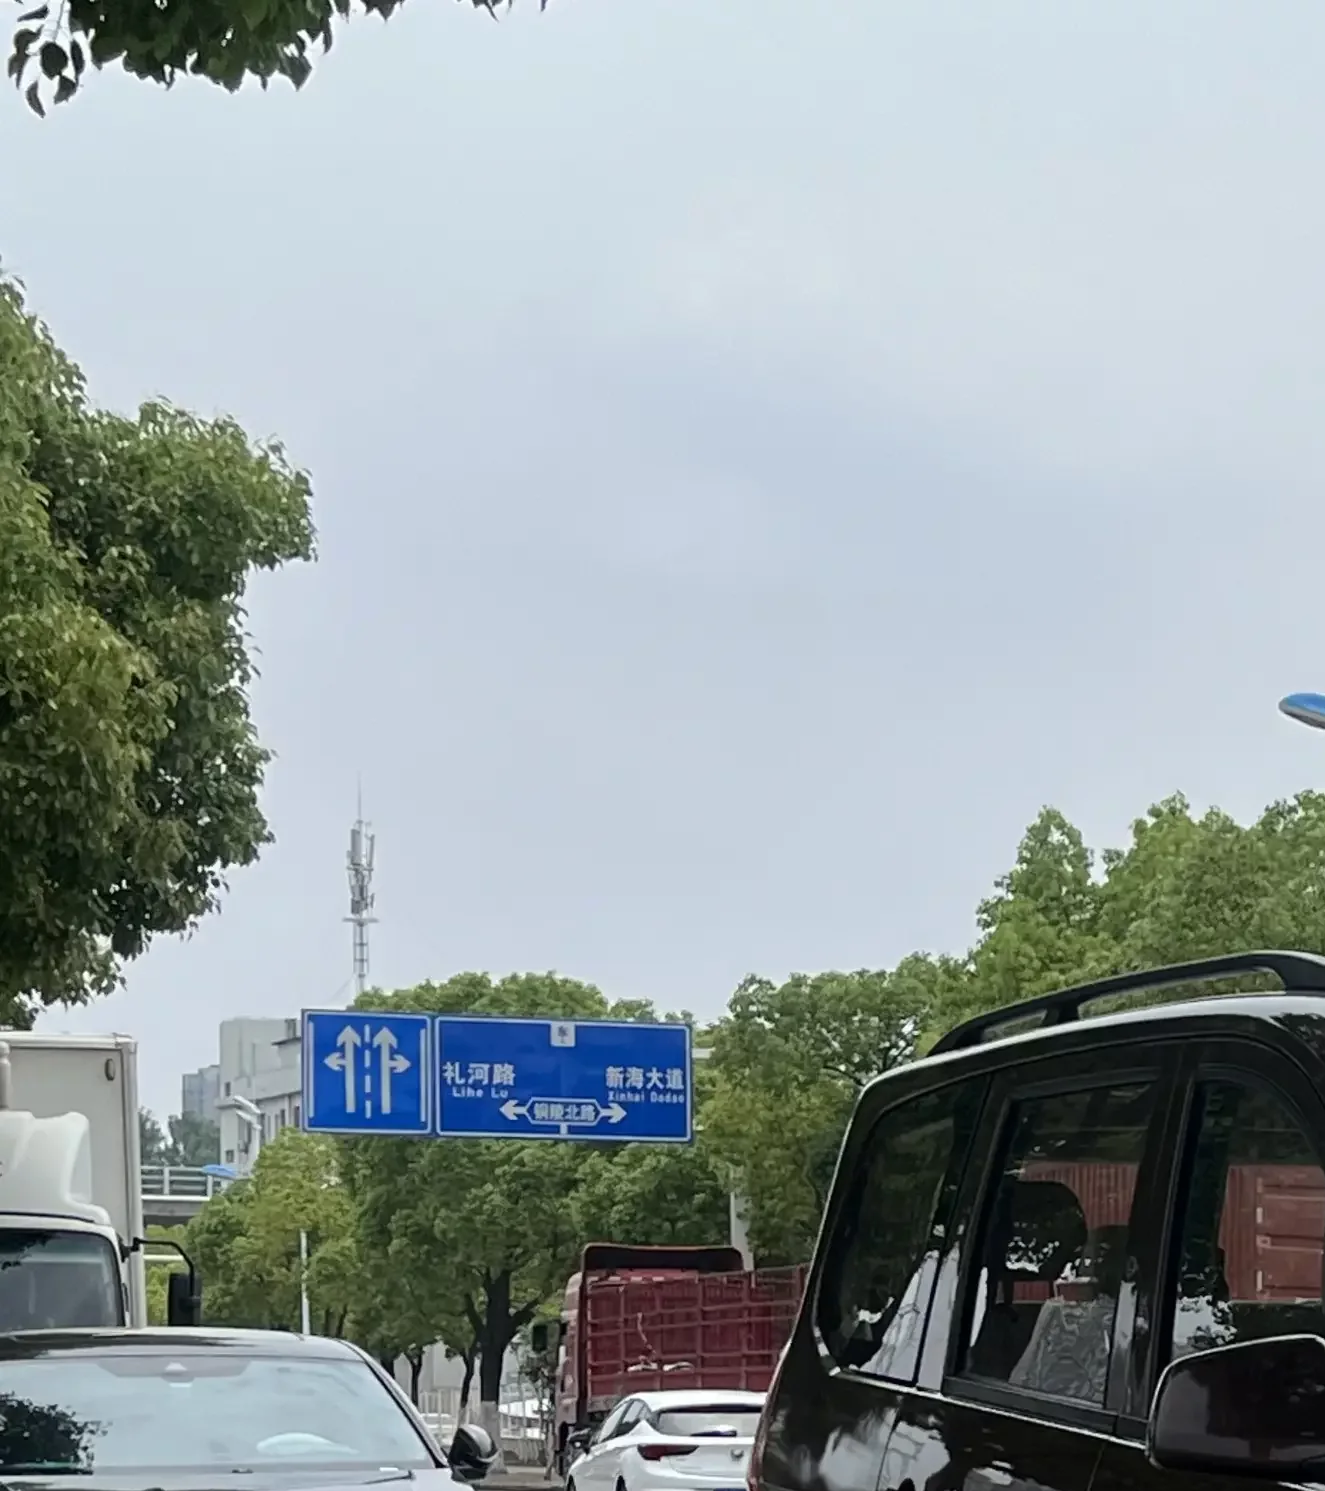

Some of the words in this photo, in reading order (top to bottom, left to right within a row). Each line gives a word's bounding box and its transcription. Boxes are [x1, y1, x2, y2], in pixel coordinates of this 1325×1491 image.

[443, 1061, 516, 1087] 礼河路
[605, 1065, 685, 1091] 新海大道
[453, 1087, 483, 1099] Lihe
[491, 1088, 509, 1099] Lu
